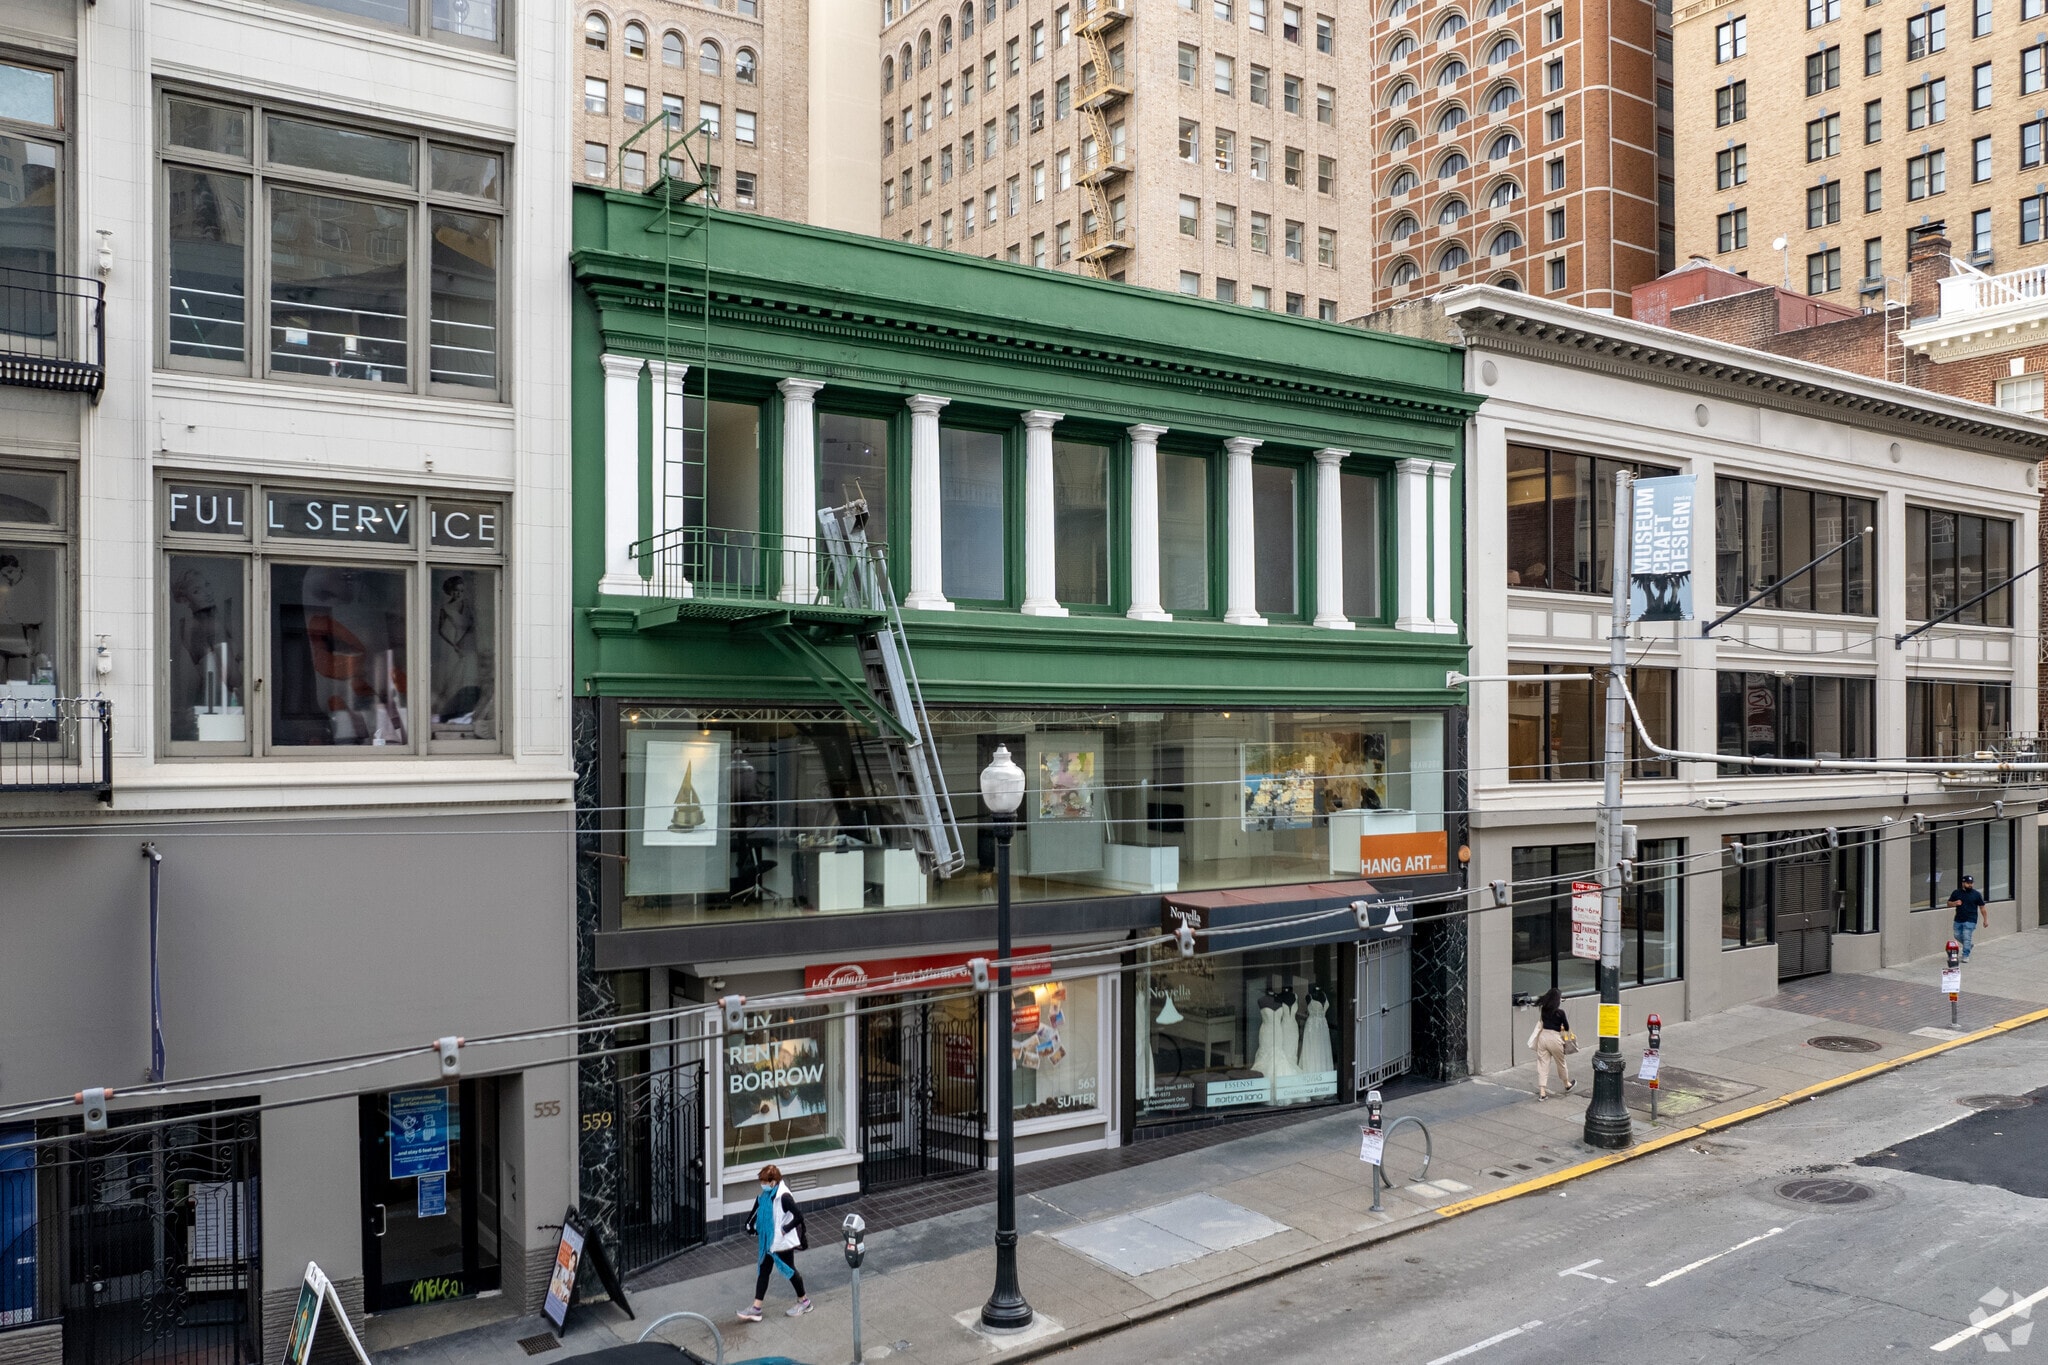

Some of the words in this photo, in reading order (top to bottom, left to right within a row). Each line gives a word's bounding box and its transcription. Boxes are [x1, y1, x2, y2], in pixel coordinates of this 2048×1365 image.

[170, 493, 284, 528] FULL
[305, 502, 495, 541] SERVICE
[1634, 488, 1654, 574] MUSEUM
[1671, 502, 1690, 572] DESIGN
[1653, 515, 1671, 574] CRAFT
[1361, 857, 1402, 875] HANG
[1405, 855, 1432, 871] ART
[1170, 906, 1201, 922] Novella
[1573, 923, 1581, 932] NO
[1582, 926, 1599, 935] PARKING
[812, 978, 835, 989] LAST
[836, 974, 868, 986] MINUTE
[1149, 984, 1191, 999] Novella
[744, 1014, 772, 1035] UY
[730, 1042, 782, 1066] RENT
[730, 1063, 824, 1094] BORROW
[1078, 1076, 1096, 1090] 563
[1057, 1093, 1096, 1108] SUTTER
[1215, 1094, 1243, 1104] martina
[1244, 1093, 1264, 1101] liana
[534, 1101, 561, 1119] 555
[582, 1111, 612, 1131] 559
